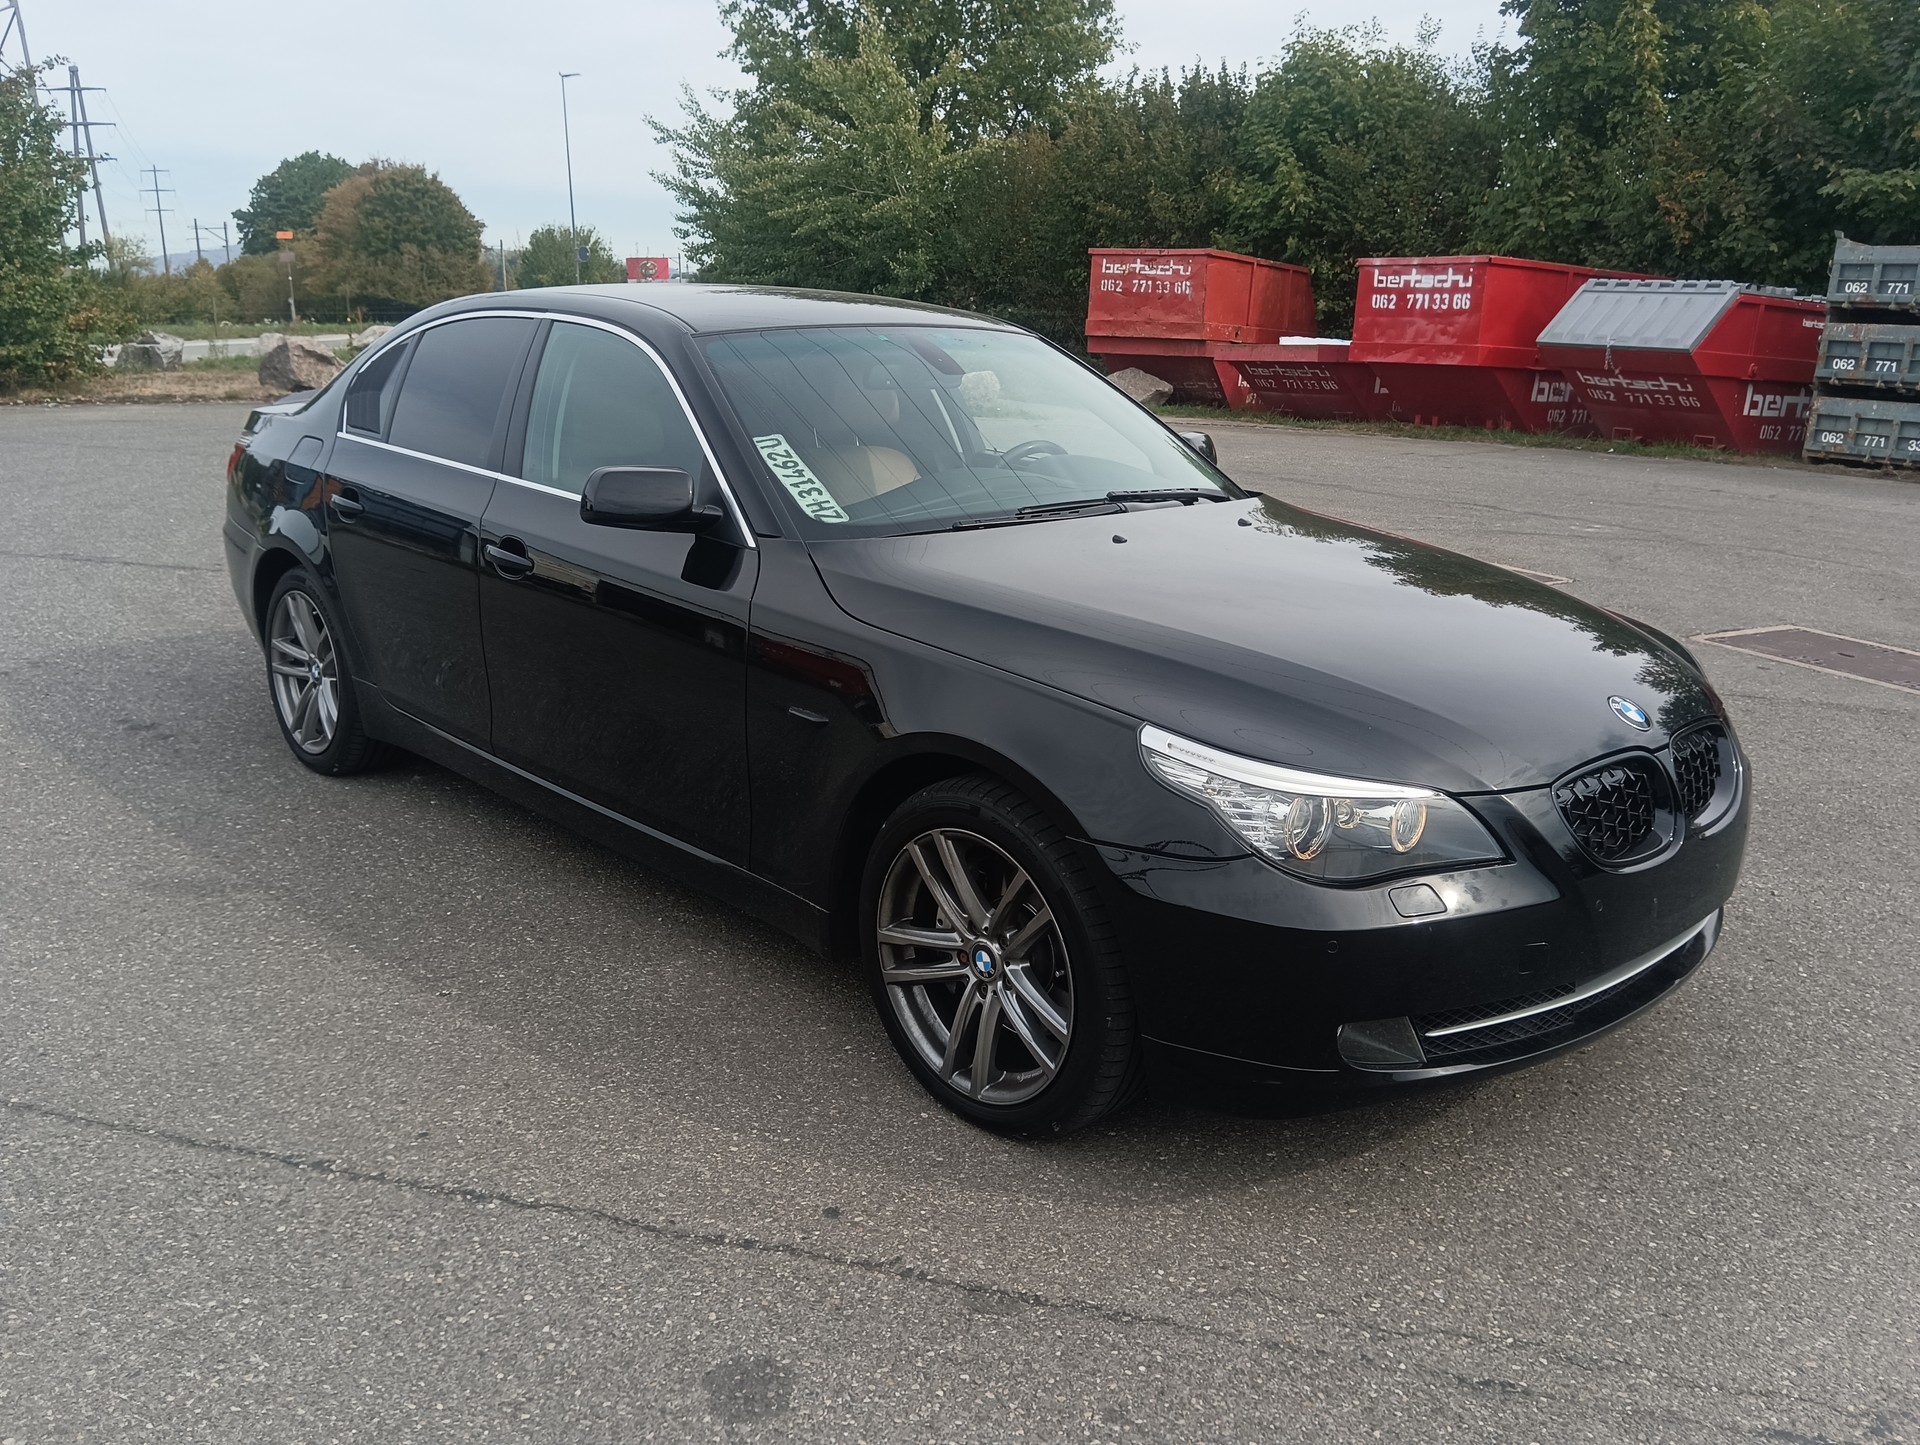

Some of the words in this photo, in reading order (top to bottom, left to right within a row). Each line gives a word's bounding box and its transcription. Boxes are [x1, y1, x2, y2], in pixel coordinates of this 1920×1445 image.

[1101, 258, 1192, 275] bertschi
[1373, 267, 1473, 288] bertschi
[1100, 279, 1123, 292] 062
[1132, 280, 1152, 293] 771
[1844, 282, 1868, 293] 062
[1887, 283, 1910, 294] 771
[1371, 294, 1397, 310] 062
[1244, 363, 1331, 377] bertschi
[1832, 358, 1856, 370] 062
[1875, 360, 1897, 372] 771
[1254, 378, 1278, 389] 062
[1576, 370, 1693, 392] bertschi
[1587, 388, 1617, 402] 062
[1547, 409, 1566, 422] 062
[1759, 424, 1781, 440] 062
[1821, 432, 1844, 444] 062
[1864, 435, 1886, 448] 771
